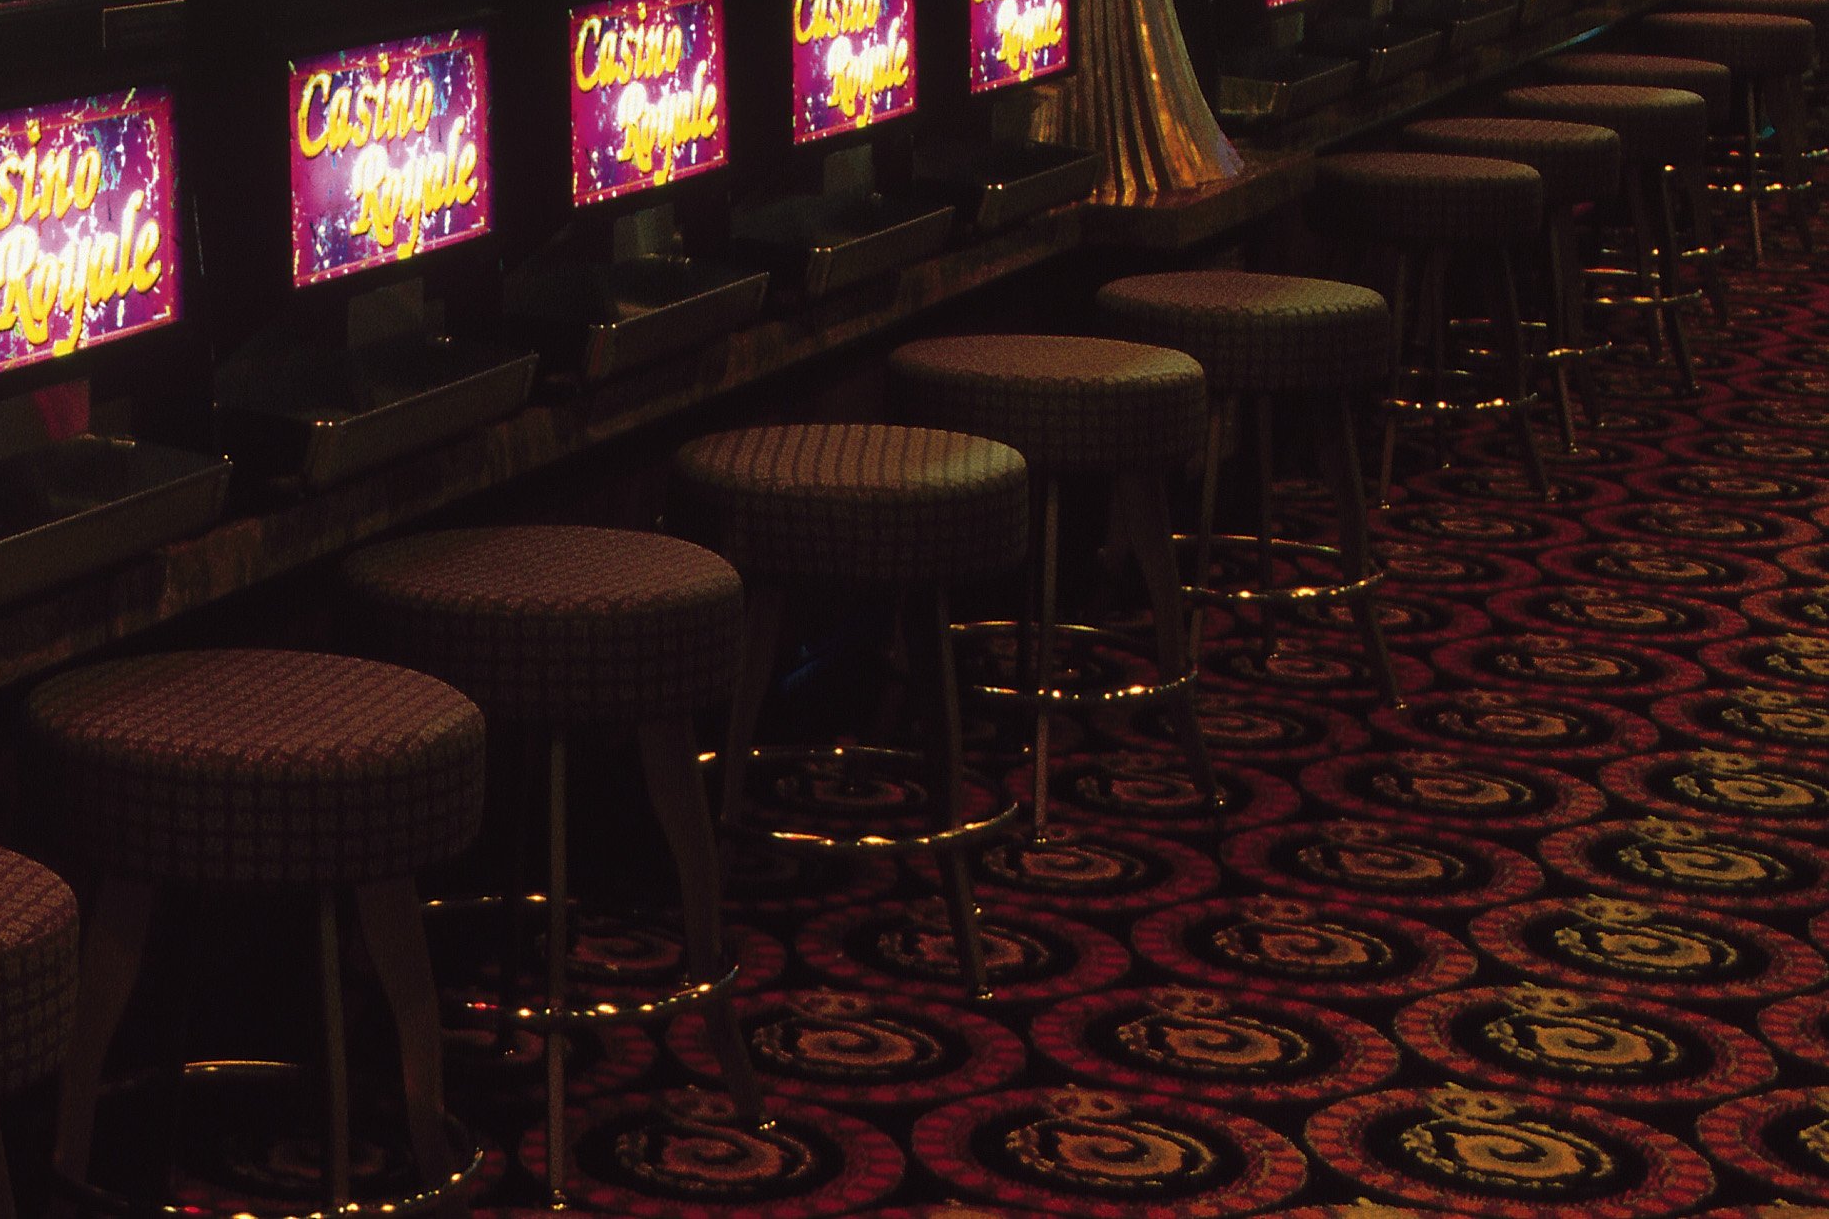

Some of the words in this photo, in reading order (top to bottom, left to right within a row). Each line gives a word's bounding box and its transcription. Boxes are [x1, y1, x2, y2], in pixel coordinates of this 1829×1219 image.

[574, 1, 684, 92] Casino
[825, 17, 911, 128] Royale
[296, 52, 435, 160] Casino
[617, 60, 719, 185] Royale
[349, 115, 480, 261] Royale
